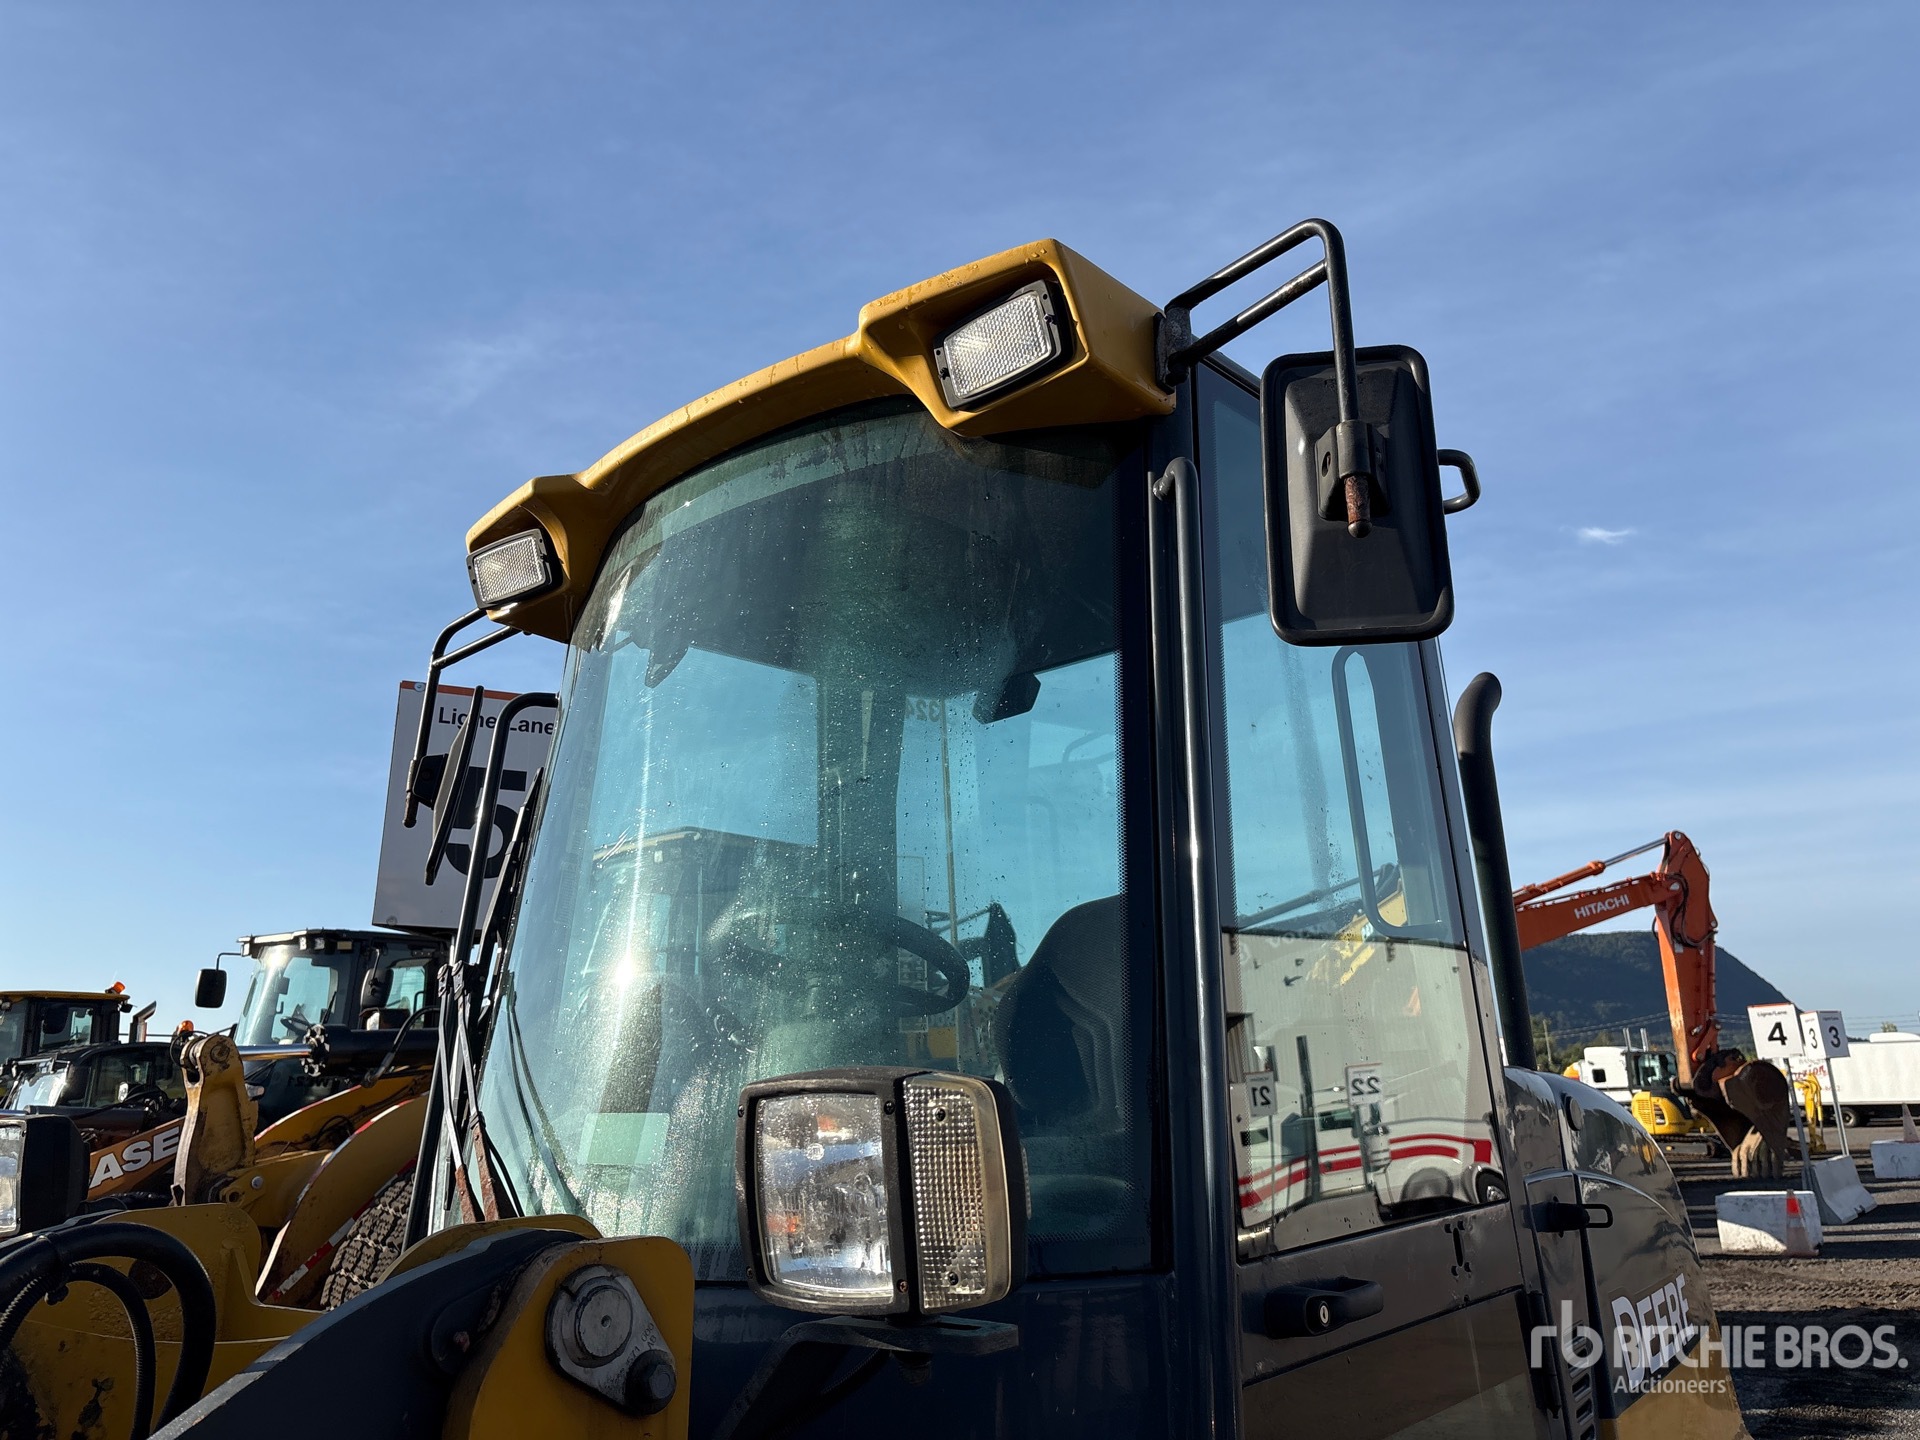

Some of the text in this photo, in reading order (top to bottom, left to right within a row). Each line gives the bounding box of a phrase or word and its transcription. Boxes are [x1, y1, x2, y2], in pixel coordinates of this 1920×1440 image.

[443, 765, 527, 880] 5
[1574, 893, 1630, 920] HITACHI
[1767, 1021, 1788, 1046] 4
[1808, 1027, 1818, 1049] 3
[1828, 1025, 1841, 1048] 3
[88, 1126, 180, 1189] ASE
[1611, 1273, 1695, 1391] DEERE
